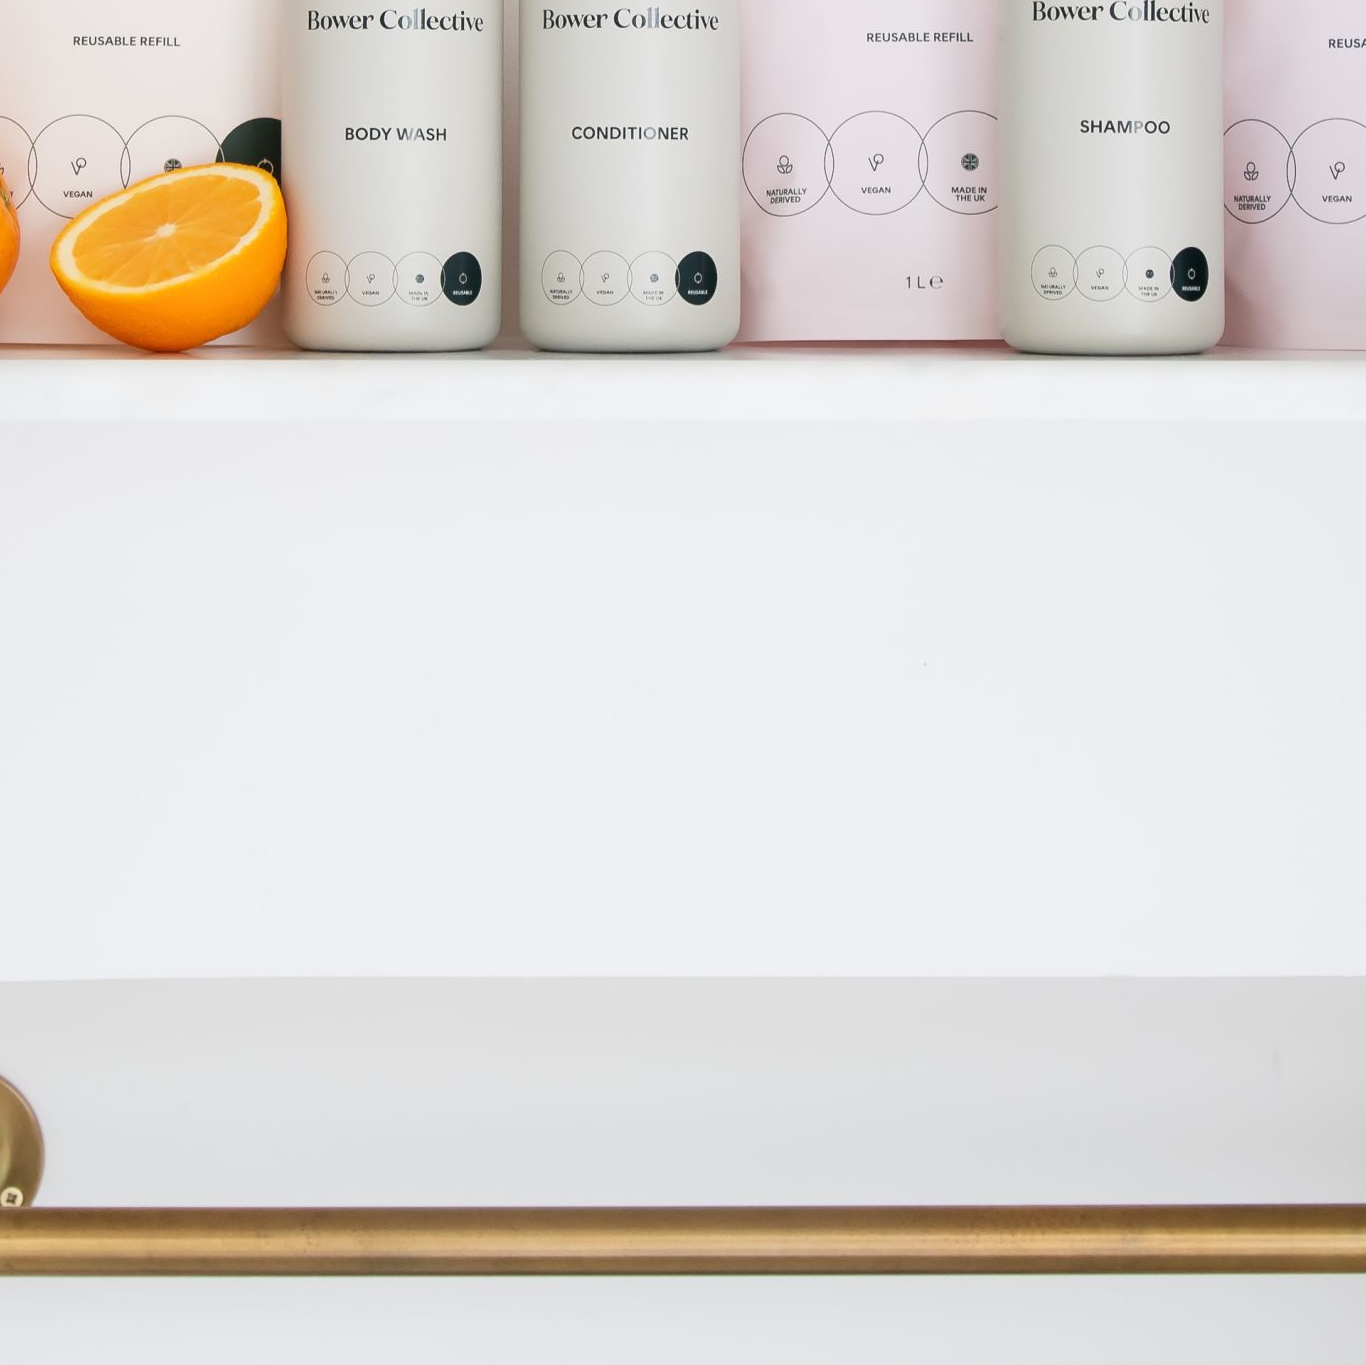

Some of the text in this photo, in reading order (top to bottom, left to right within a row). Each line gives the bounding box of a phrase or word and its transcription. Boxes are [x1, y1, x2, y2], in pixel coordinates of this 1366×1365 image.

[1033, 0, 1209, 24] Bower Collective
[308, 8, 483, 32] Bower Collective
[543, 8, 718, 30] Bower Collective
[73, 36, 180, 46] REUSABLE REFILL
[867, 32, 974, 42] REUSABLE REFILL
[1080, 120, 1170, 134] SHAMPOO
[346, 127, 446, 141] BODY WASH
[572, 126, 688, 140] CONDITIONER
[63, 190, 93, 198] VEGAN
[766, 187, 808, 197] NATURALLY
[769, 196, 802, 204] DERIVED
[955, 194, 971, 202] THE
[1233, 195, 1272, 203] NATURALLY
[1238, 203, 1266, 211] DERIVED
